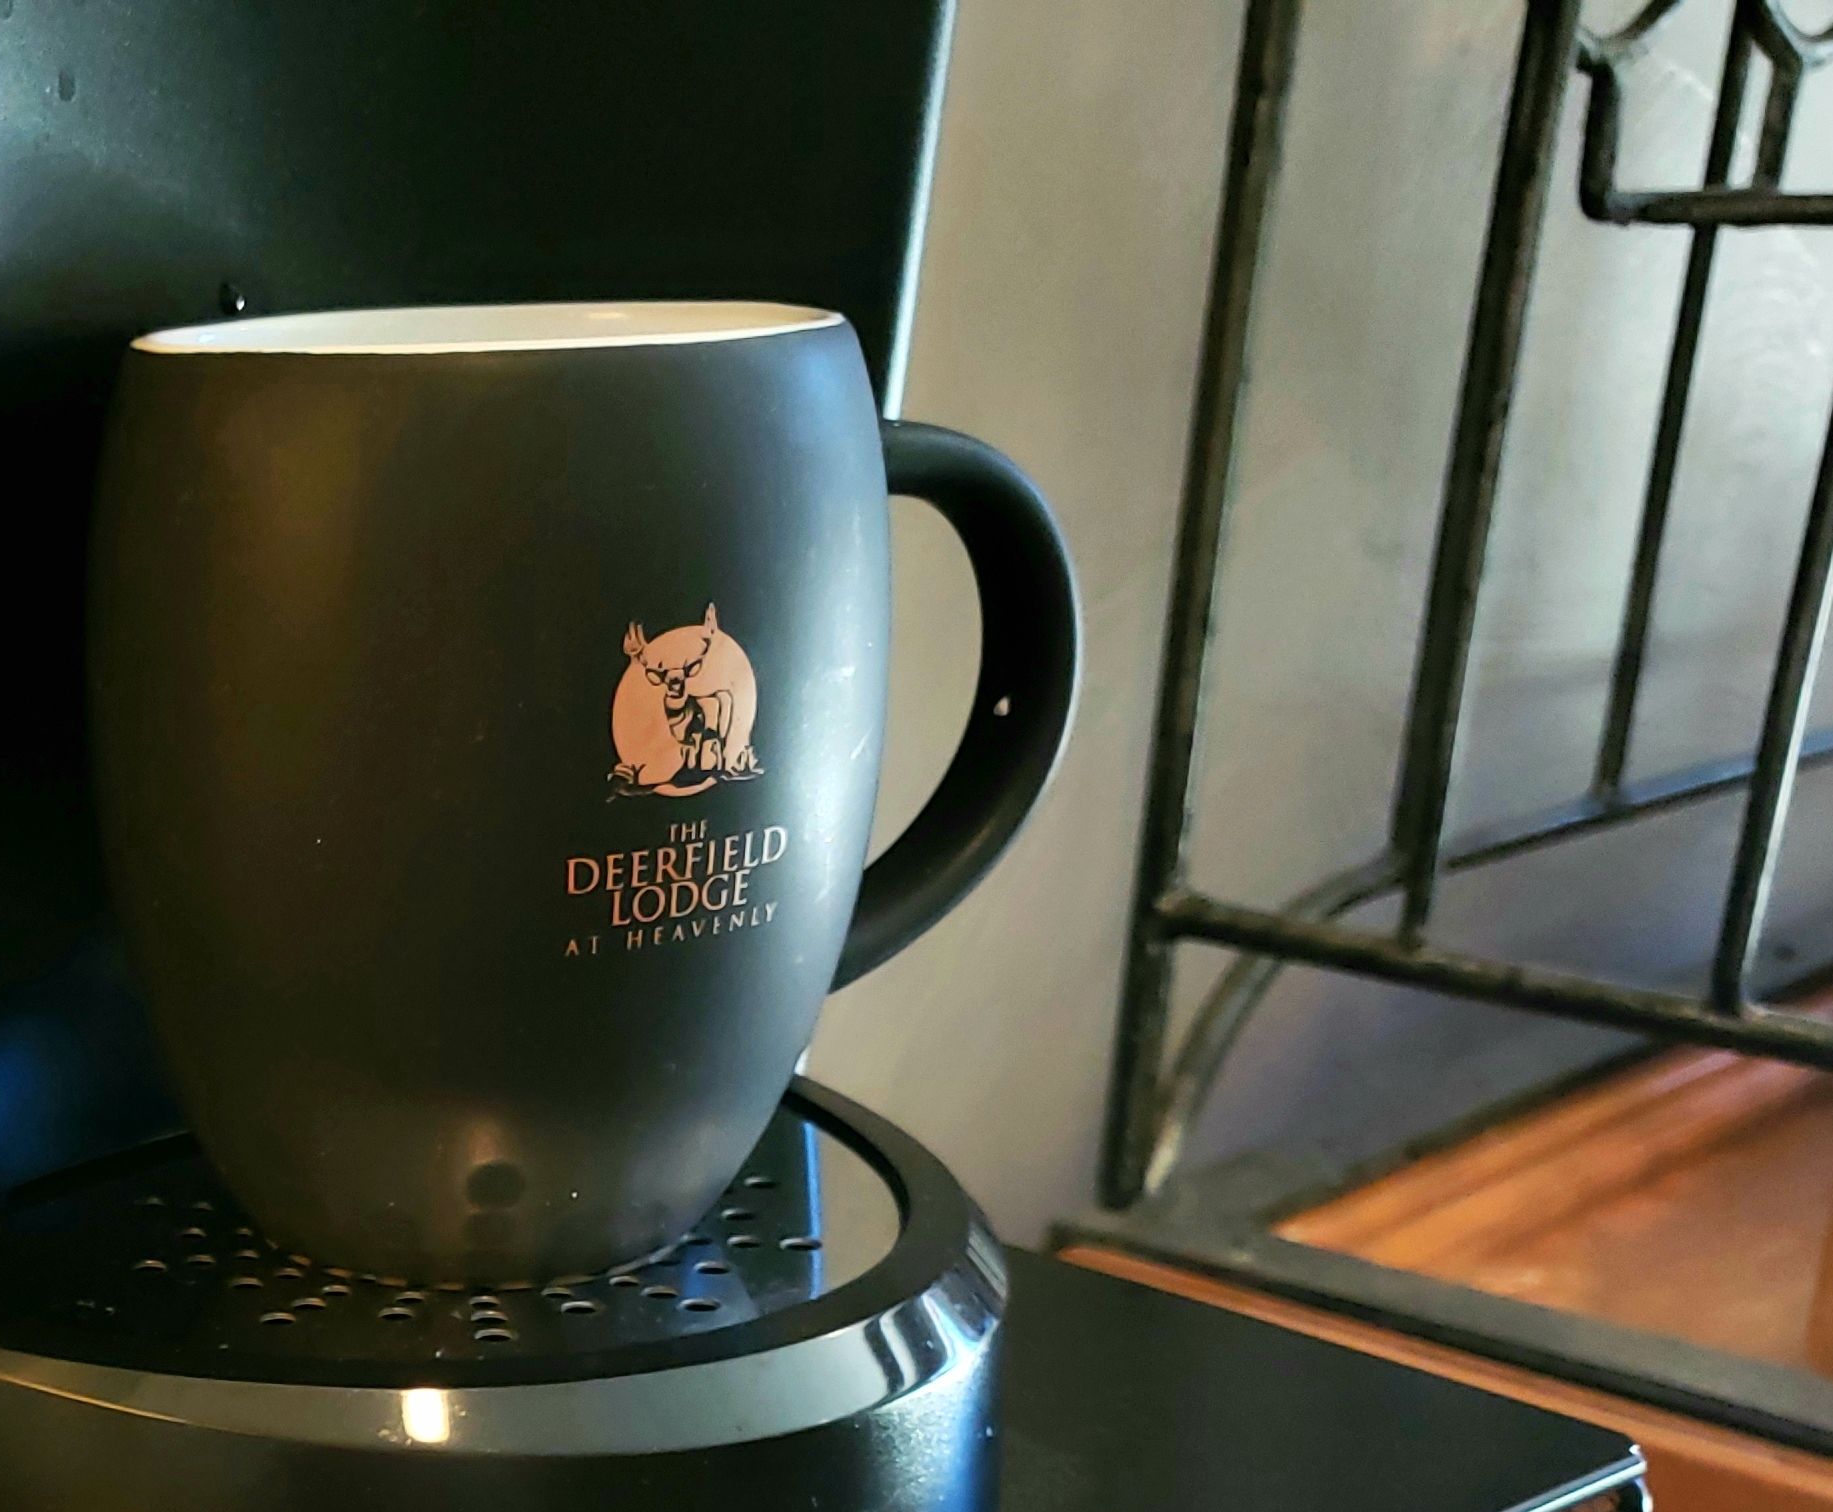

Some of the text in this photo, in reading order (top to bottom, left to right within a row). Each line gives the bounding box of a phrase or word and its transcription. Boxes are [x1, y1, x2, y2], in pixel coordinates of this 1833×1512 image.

[669, 820, 708, 842] THE
[567, 826, 788, 895] DEERFIELD
[611, 870, 751, 927] LODGE
[565, 903, 778, 957] AT HEAVENLY
